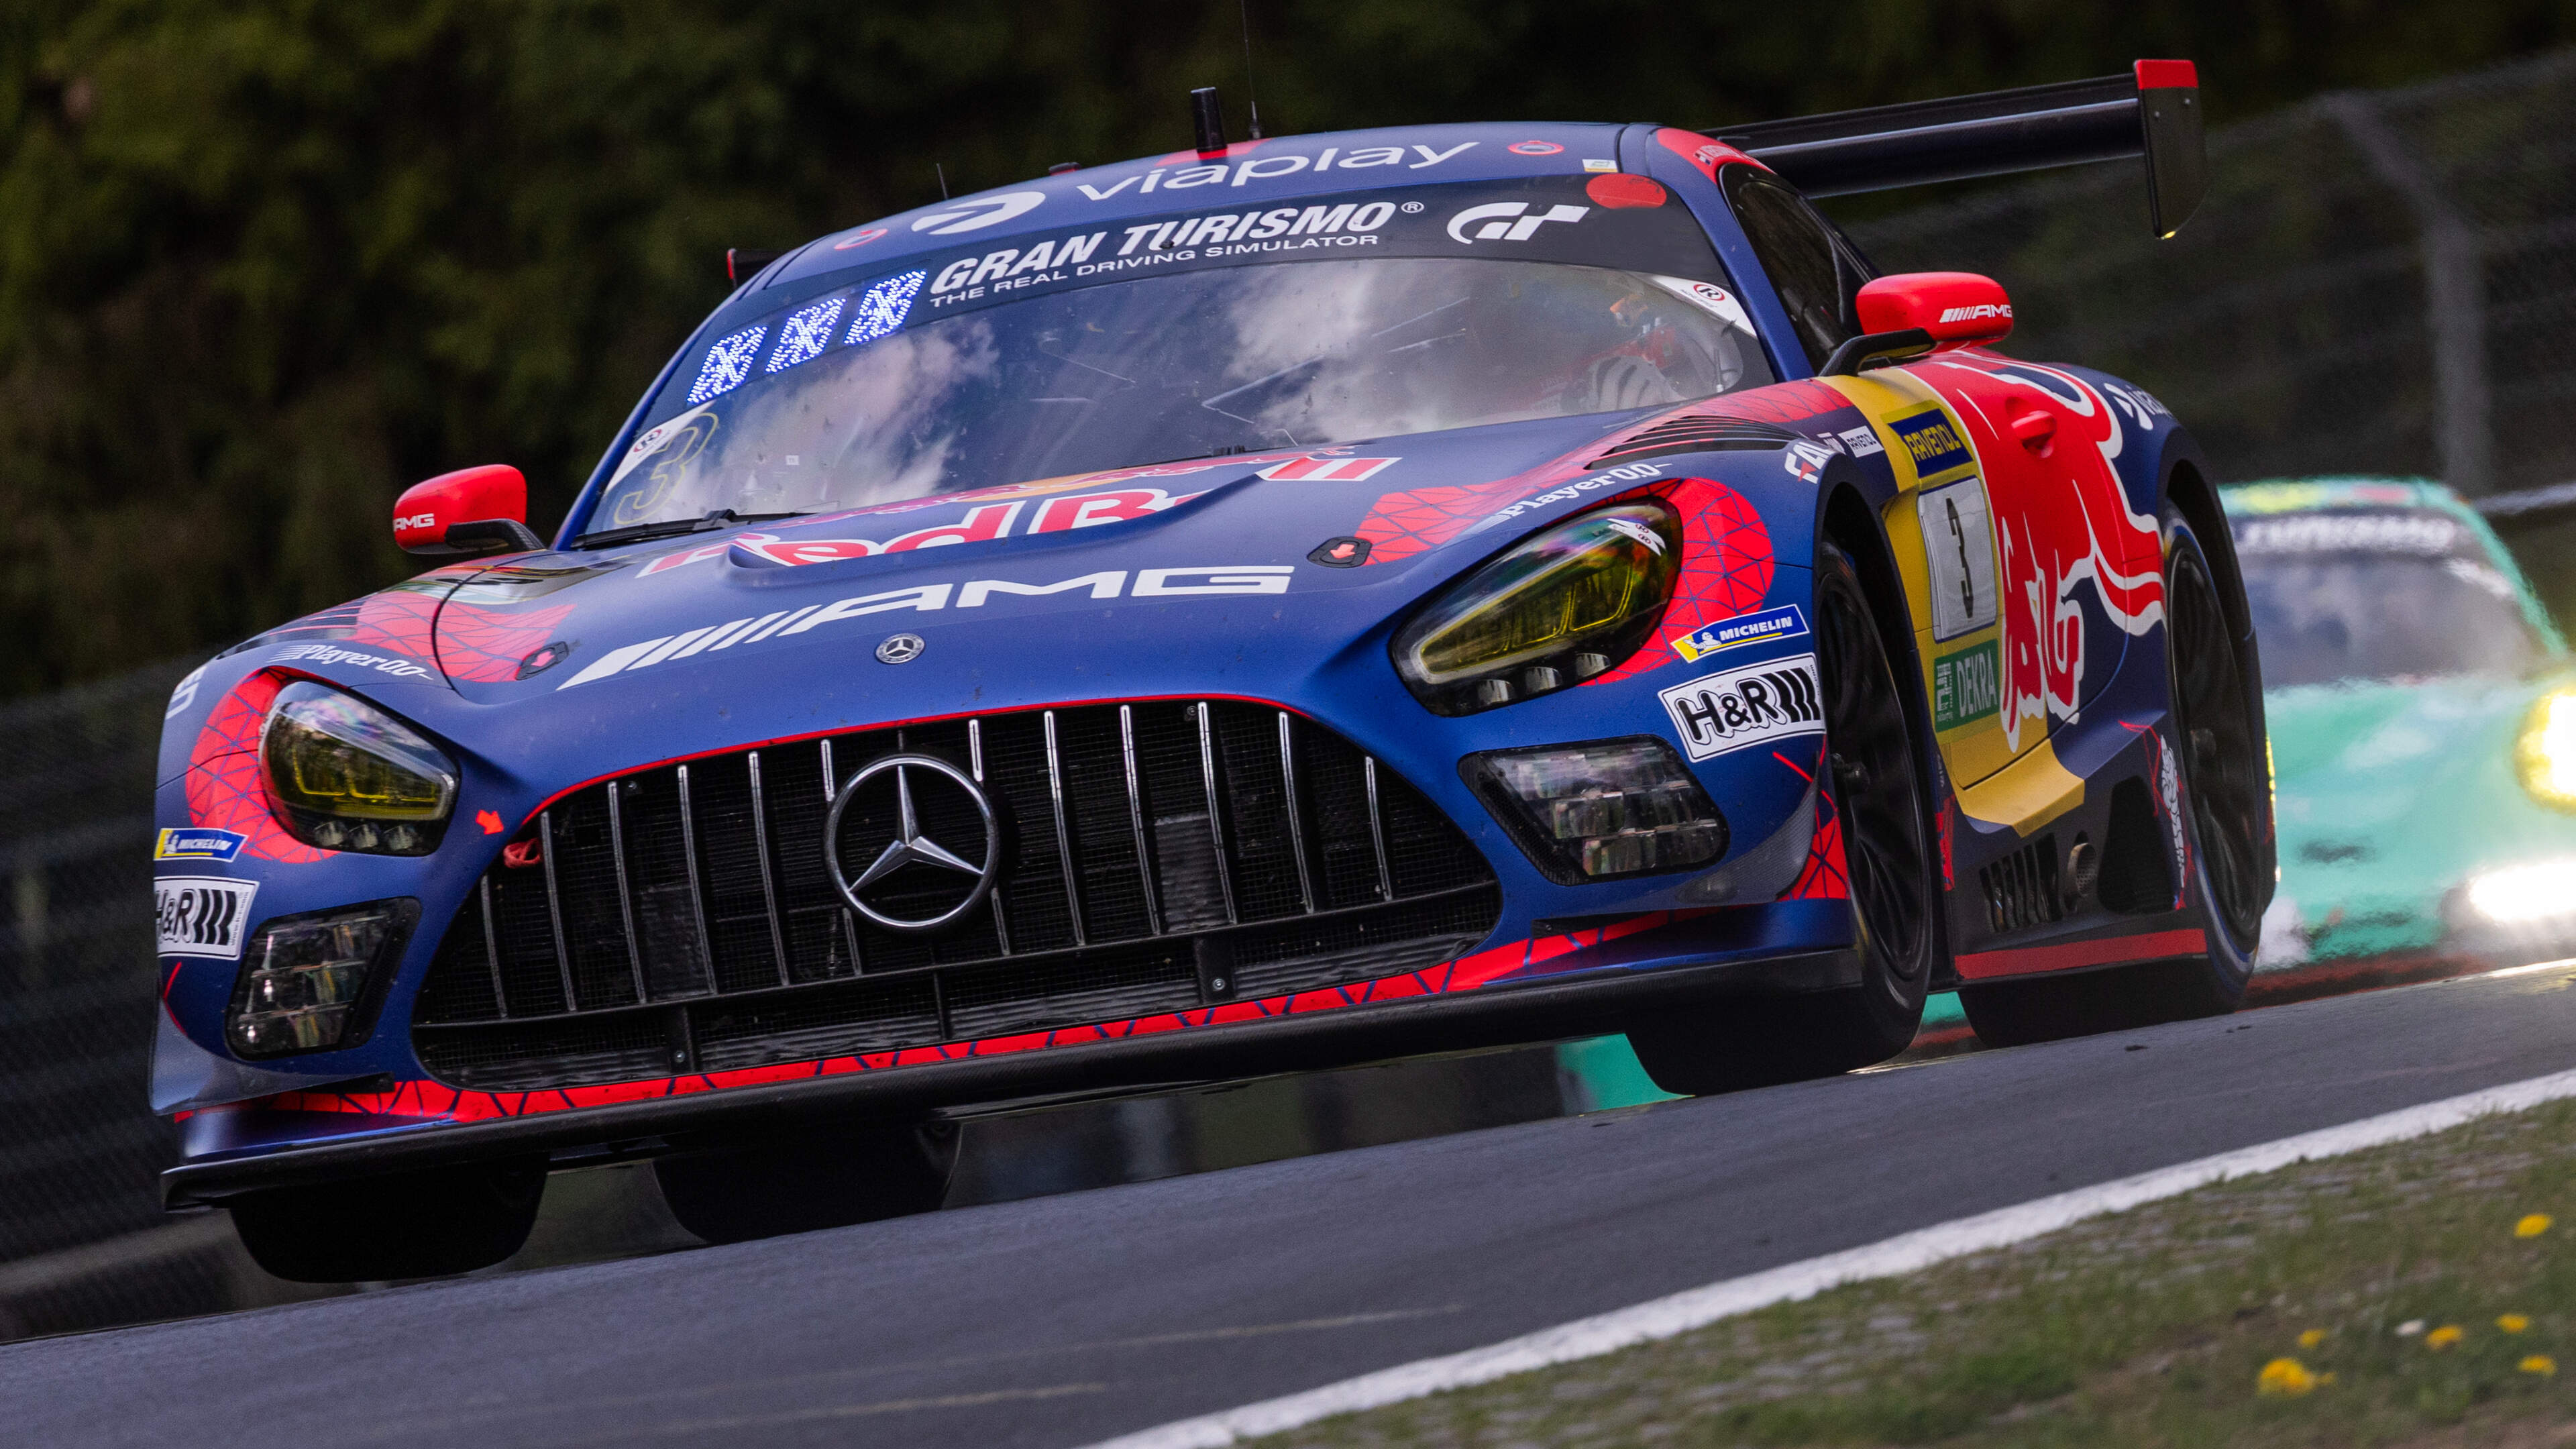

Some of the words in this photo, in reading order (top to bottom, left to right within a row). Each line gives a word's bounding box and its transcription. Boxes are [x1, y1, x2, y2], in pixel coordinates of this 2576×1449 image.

[1077, 142, 1480, 201] viaplay
[930, 231, 1107, 294] GRAN
[1117, 202, 1396, 256] TURISMO
[930, 286, 985, 307] THE
[994, 270, 1068, 292] REAL
[1076, 251, 1195, 276] DRIVING
[1205, 235, 1378, 258] SIMULATOR
[1903, 423, 1962, 462] RAVENOL
[1945, 497, 1974, 619] 3
[777, 565, 1295, 637] AMG
[1719, 616, 1793, 641] MICHELIN
[1676, 678, 1780, 741] H&R
[1955, 648, 1998, 718] DEKRA
[176, 839, 233, 851] MICHELIN
